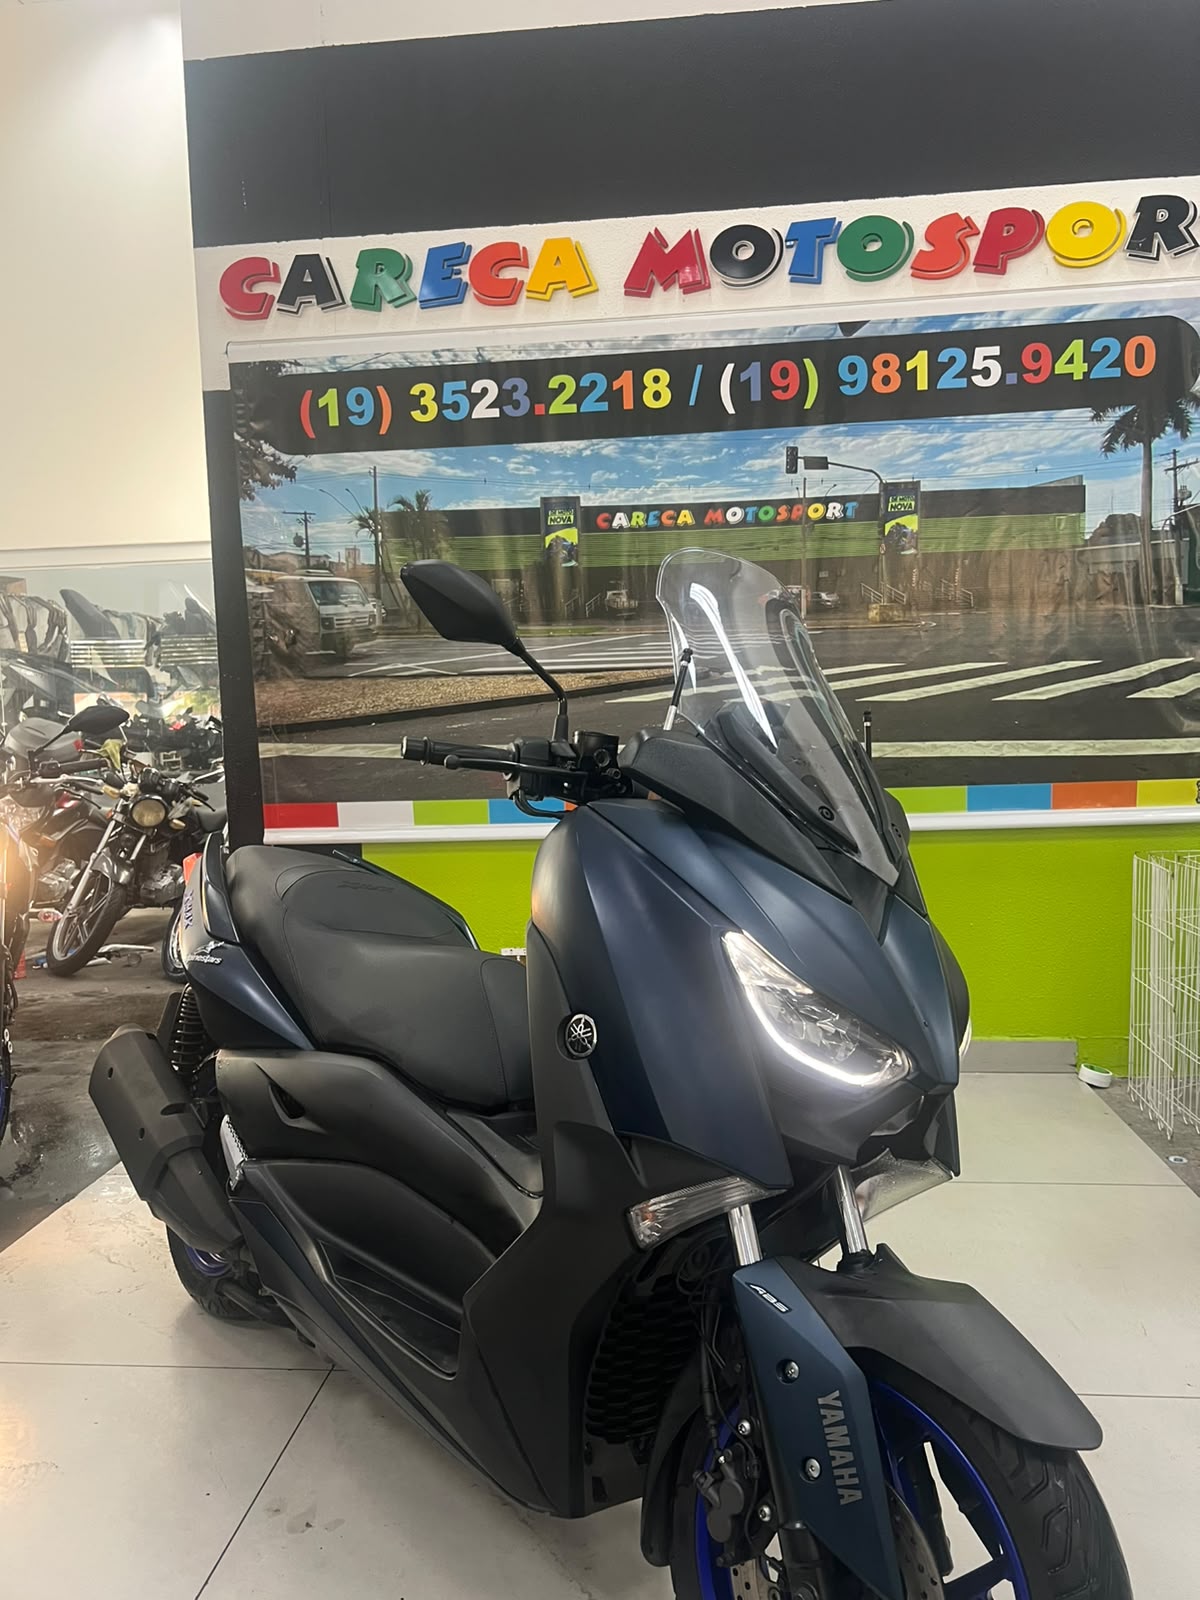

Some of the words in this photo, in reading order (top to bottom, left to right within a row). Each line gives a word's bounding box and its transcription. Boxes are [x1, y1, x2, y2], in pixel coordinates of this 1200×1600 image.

[219, 236, 599, 320] CARECA
[624, 194, 1199, 299] MOTOSPOR
[300, 384, 393, 439] (19)
[409, 368, 672, 423] 3523.2218
[688, 364, 703, 407] /
[719, 357, 820, 415] (19)
[838, 335, 1157, 397] 98125.9420
[549, 516, 573, 525] NOVA
[596, 509, 696, 530] CARECA
[704, 501, 858, 525] MOTOSPORT
[889, 502, 914, 511] NOVA
[749, 1283, 790, 1313] ABS
[817, 1390, 863, 1506] YAMAHA
